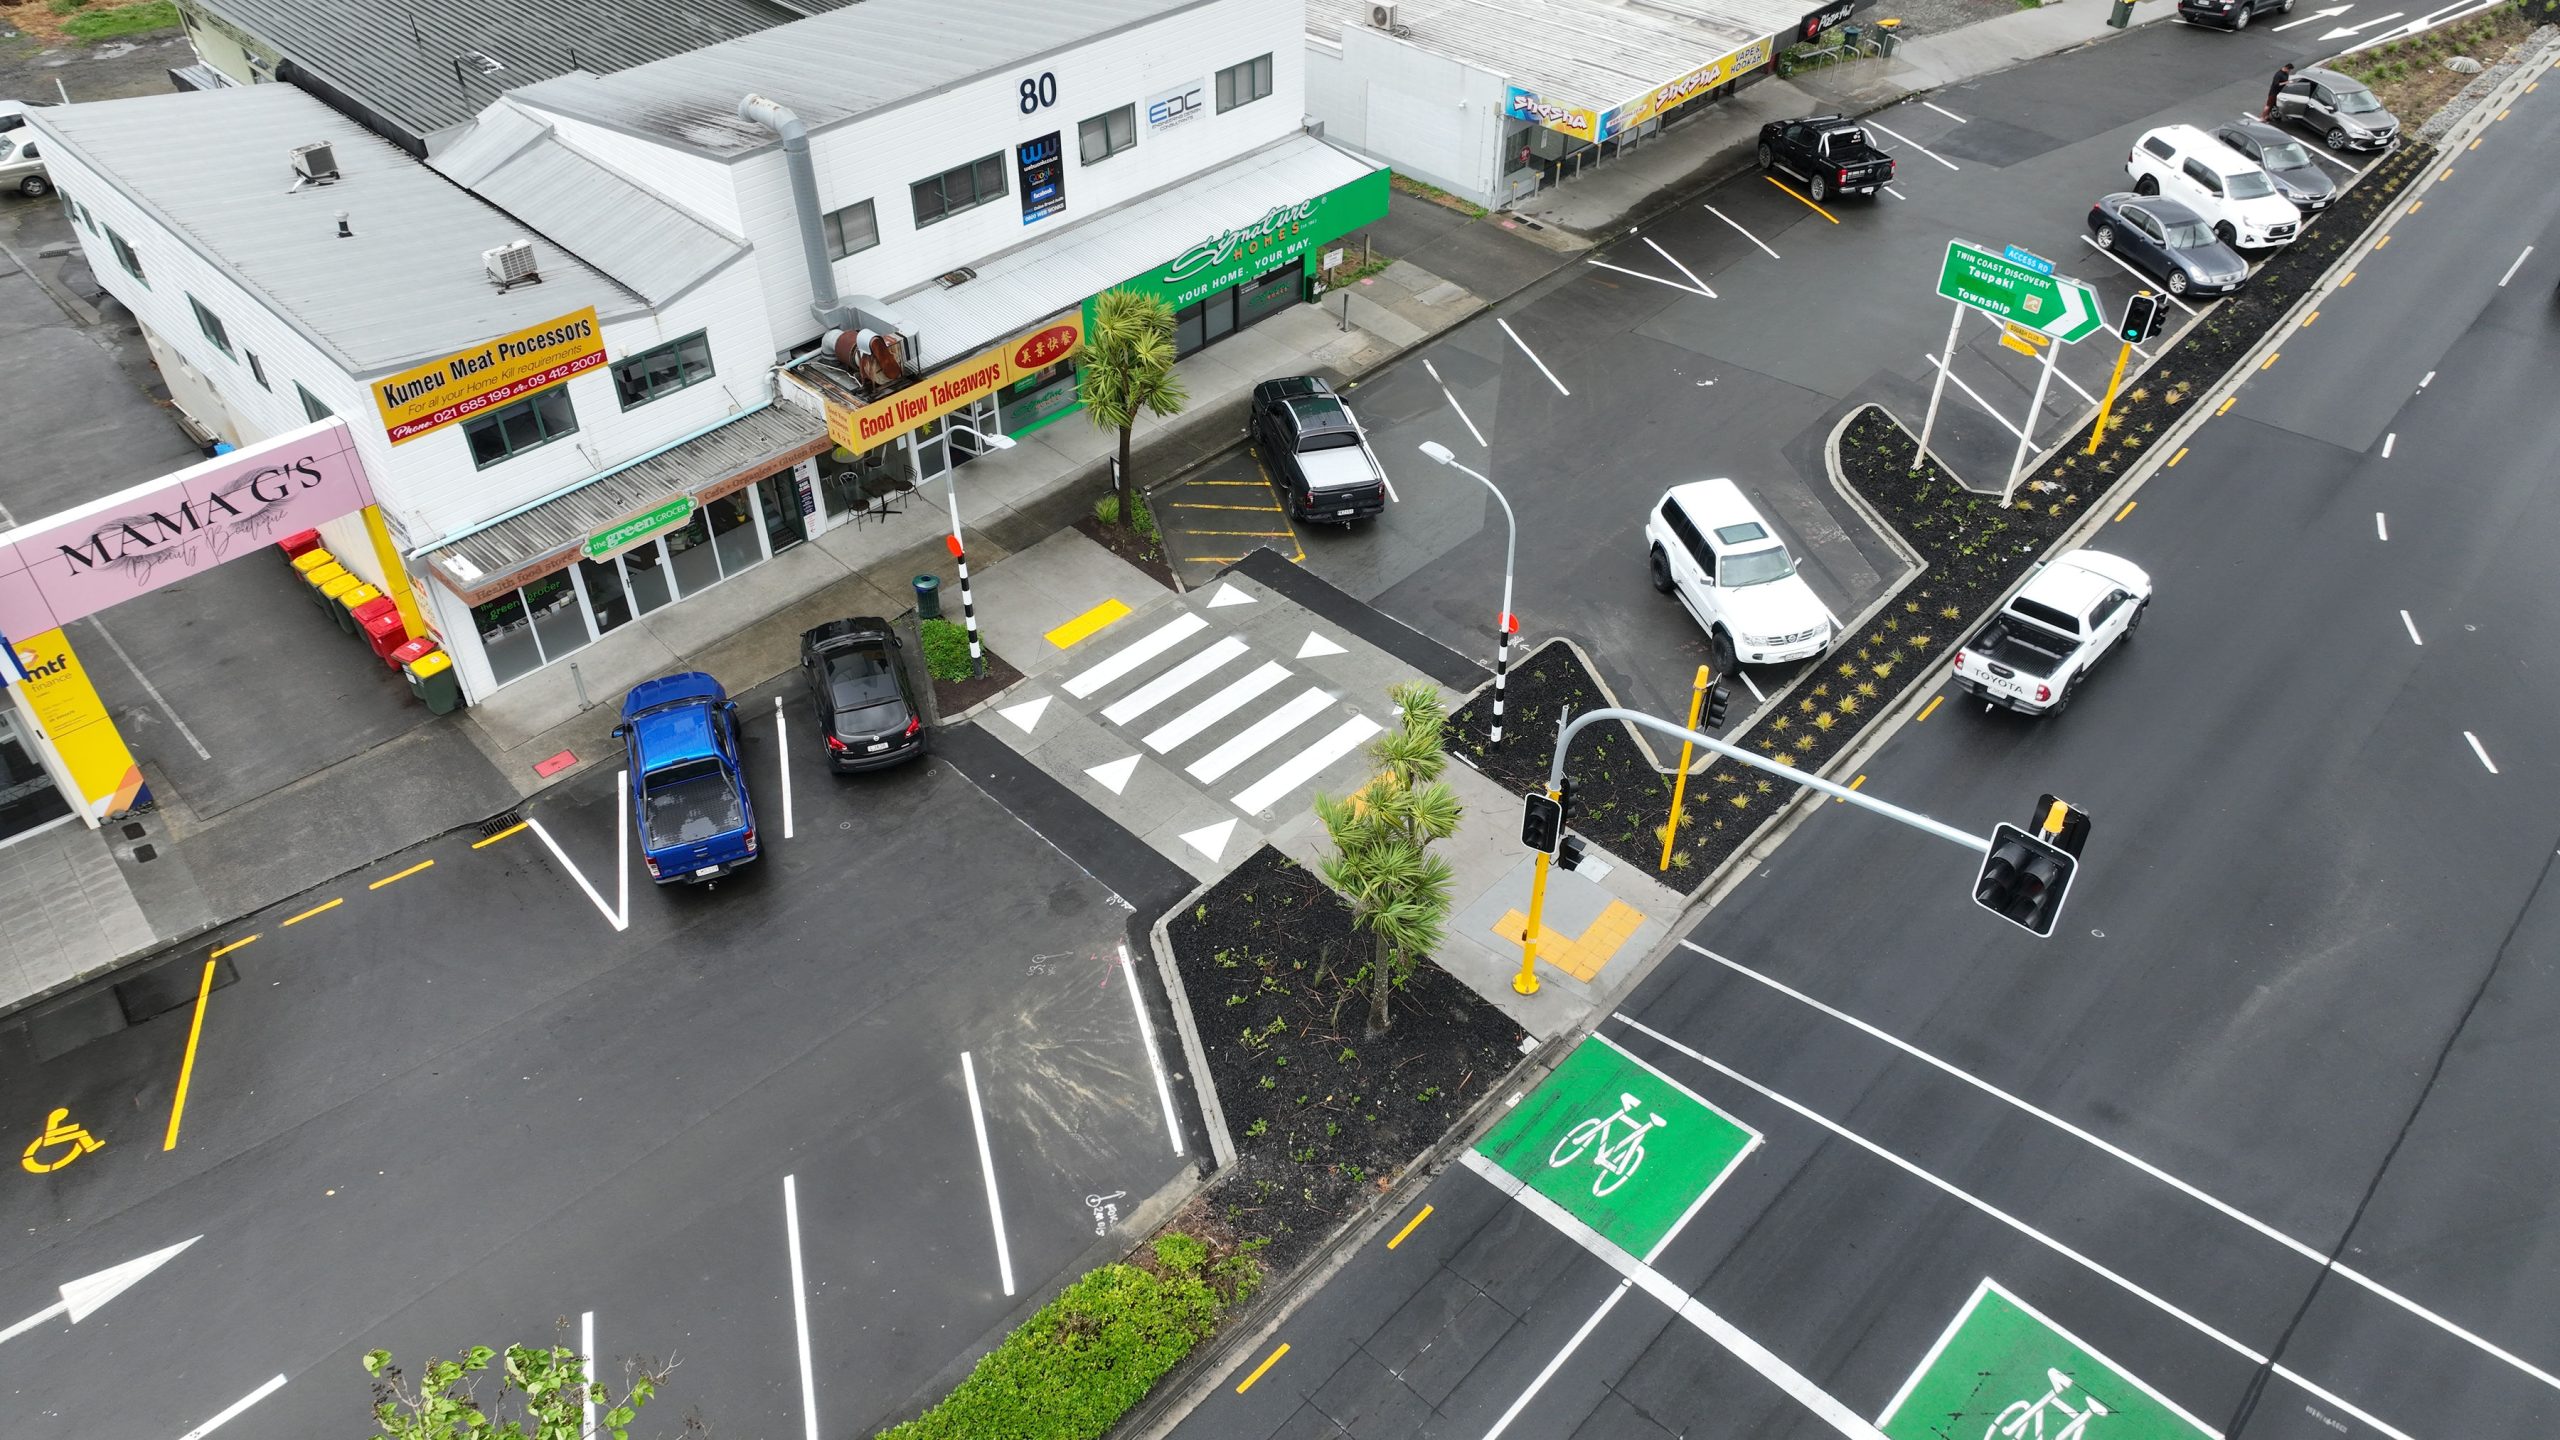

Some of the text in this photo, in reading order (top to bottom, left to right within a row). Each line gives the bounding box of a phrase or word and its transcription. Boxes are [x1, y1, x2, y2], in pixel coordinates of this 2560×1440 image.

[1817, 3, 1855, 32] Pizza Hut
[1730, 54, 1762, 74] HOOKAH
[1736, 47, 1754, 62] VAPE
[1020, 72, 1057, 114] 80
[1149, 88, 1202, 124] EDC
[1029, 166, 1055, 183] Google
[1033, 188, 1053, 199] facebook
[1163, 199, 1319, 283] Signature
[1233, 221, 1300, 261] HOMES
[1178, 284, 1208, 304] YOUR
[1254, 250, 1283, 270] YOUR
[1287, 236, 1312, 256] WAY.
[1956, 251, 2051, 290] TWIN COAST DISCOVERY
[1969, 265, 2015, 290] Taupaki
[2008, 250, 2049, 273] ACCESS RD
[1957, 287, 2011, 315] Township
[382, 318, 592, 409] Kumeu Meat Processors
[408, 344, 582, 416] For all your Home Kill requirements
[433, 408, 457, 423] 021
[459, 397, 487, 414] 685
[488, 387, 511, 403] 199
[528, 374, 546, 389] 09
[548, 366, 570, 381] 412
[571, 352, 602, 373] 2007
[859, 408, 894, 440] Good
[896, 394, 928, 424] View
[930, 362, 1001, 408] Takeaways
[704, 486, 724, 500] Cafe
[778, 448, 808, 467] Gluten
[809, 440, 826, 454] free
[56, 455, 322, 577] MAMA G'S
[593, 504, 687, 550] the green GROCER
[475, 578, 516, 600] Health
[517, 564, 543, 582] food
[545, 552, 575, 571] store
[480, 602, 494, 612] the
[489, 581, 562, 621] green grocer
[26, 653, 67, 683] mtf
[32, 672, 73, 693] finance
[1974, 668, 2024, 694] TOYOTA
